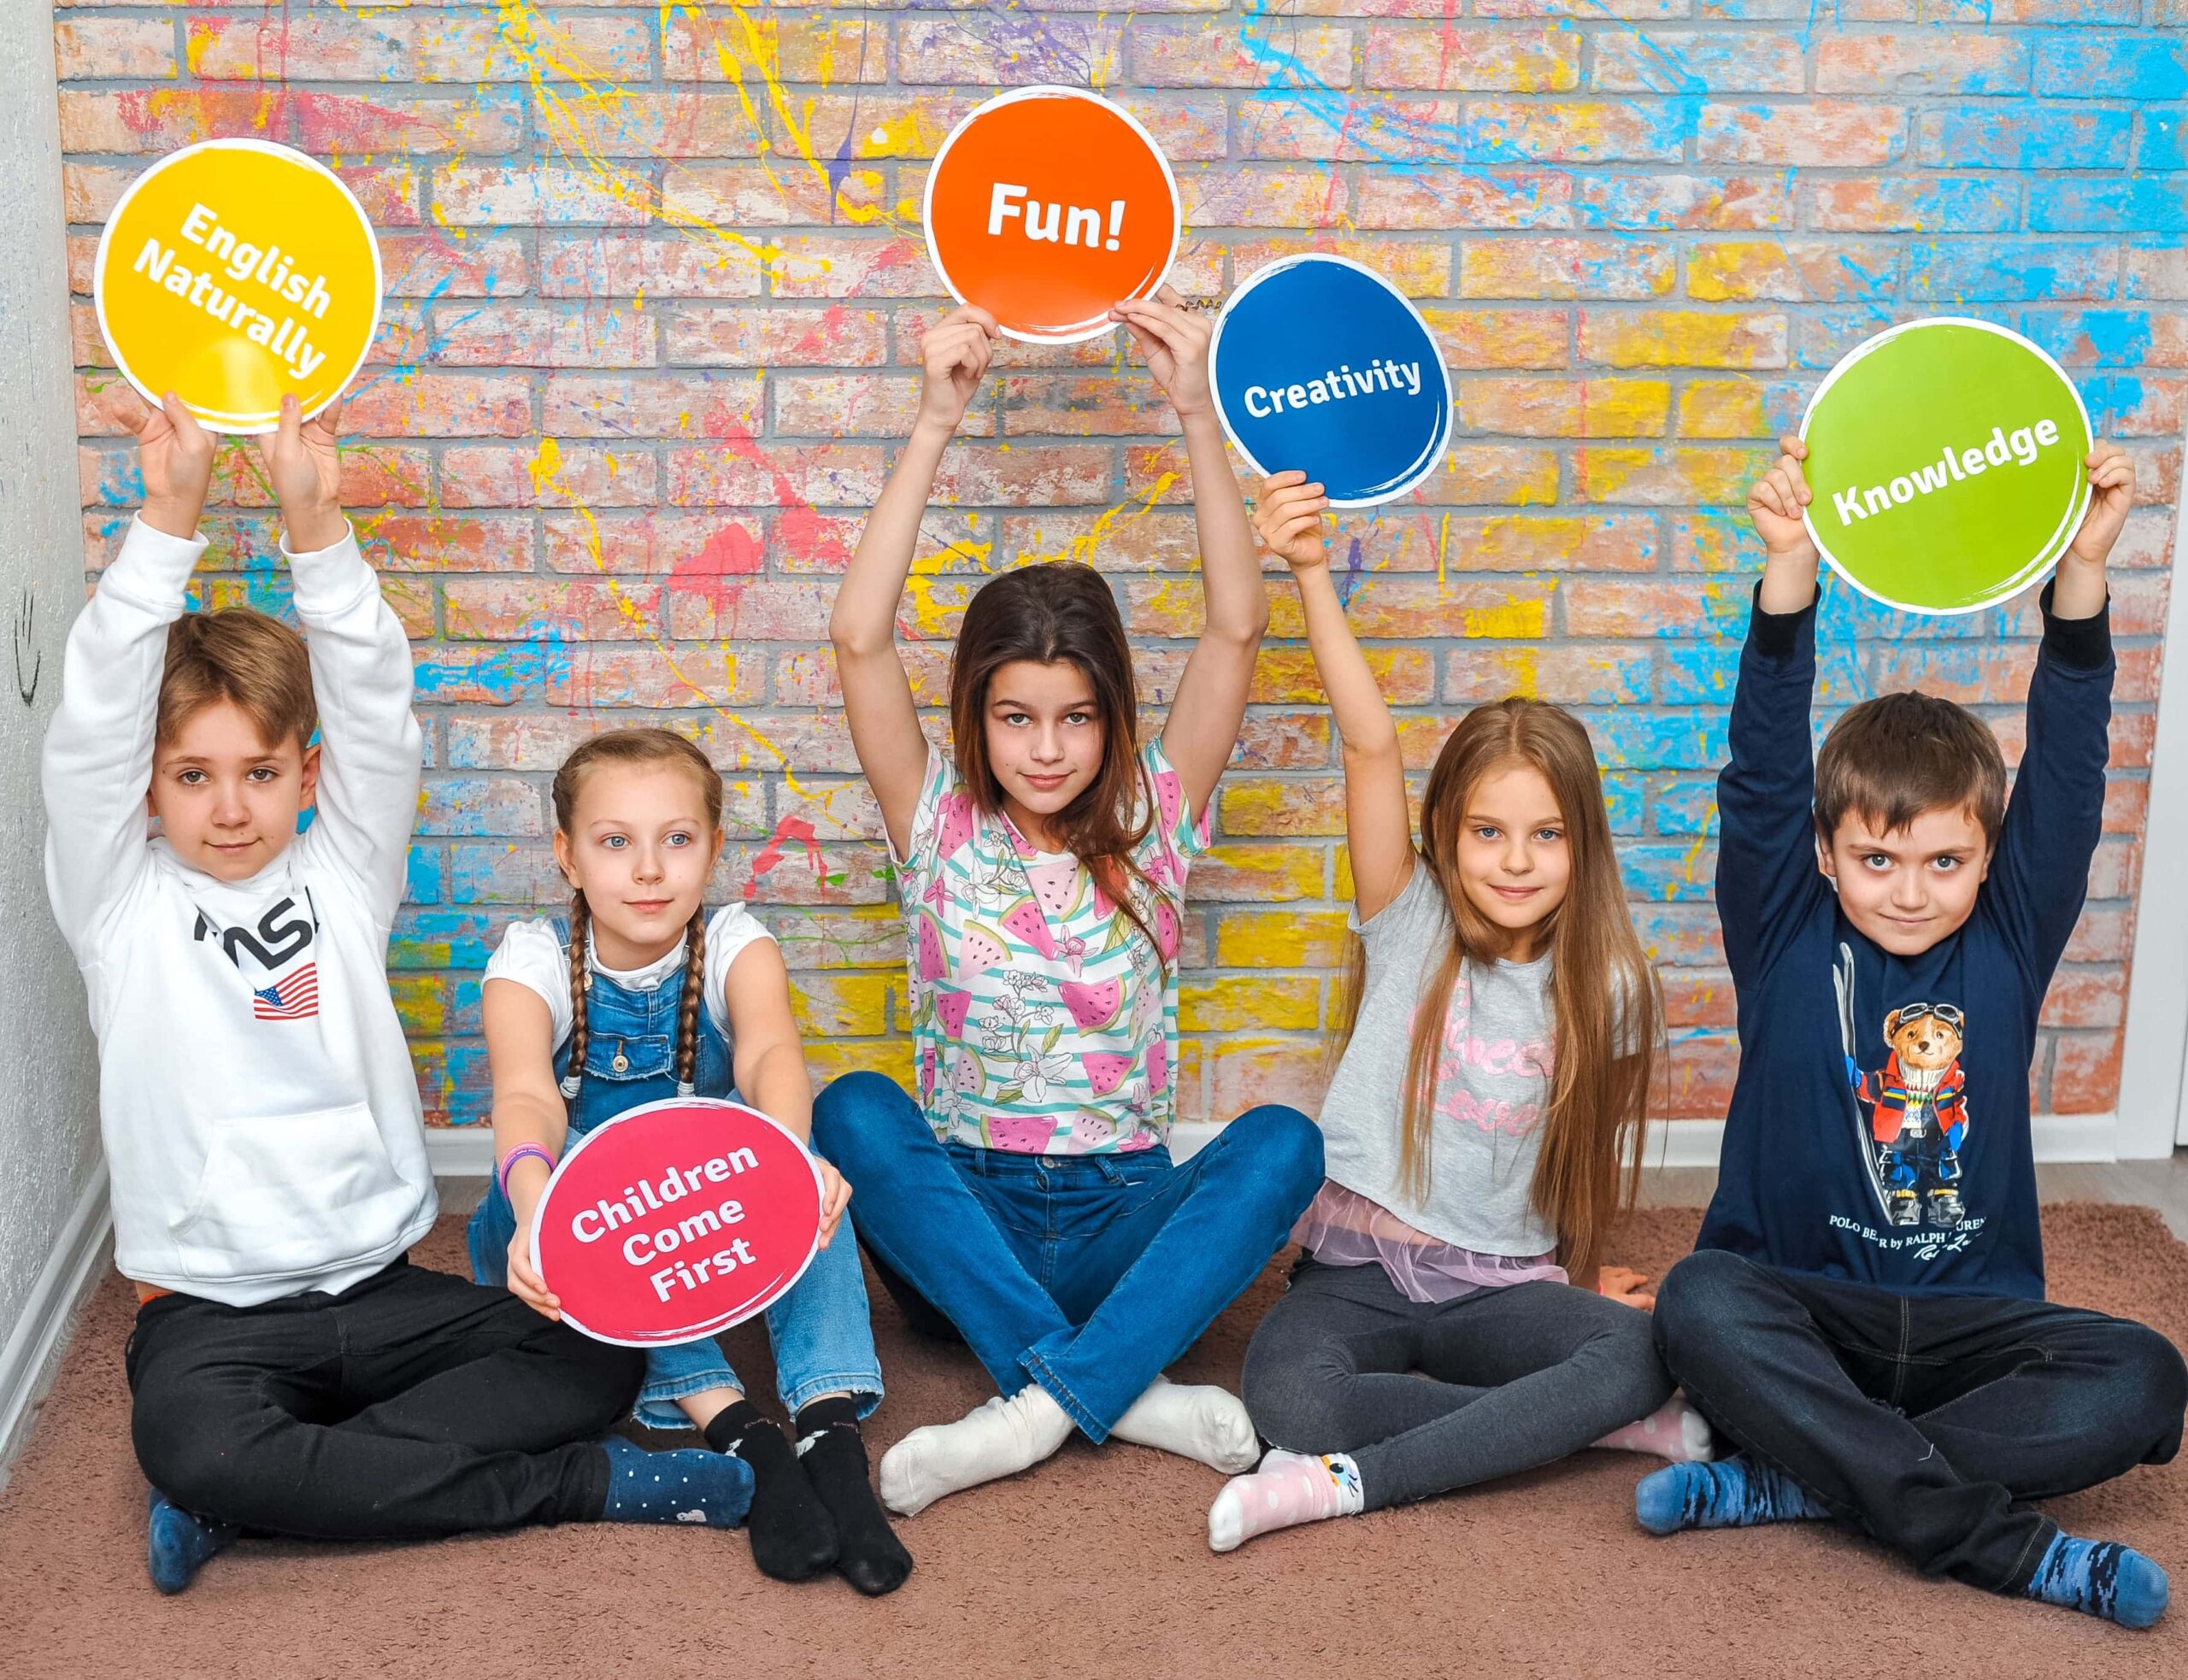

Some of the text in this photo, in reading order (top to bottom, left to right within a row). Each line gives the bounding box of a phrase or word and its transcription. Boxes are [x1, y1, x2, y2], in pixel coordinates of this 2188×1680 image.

[987, 182, 1126, 251] Fun!
[180, 203, 331, 319] English
[133, 238, 326, 379] Naturally
[1244, 359, 1420, 418] Creativity
[1832, 419, 2060, 526] Knowledge
[571, 1147, 759, 1243] Children
[623, 1200, 745, 1266] Come
[1829, 1215, 1861, 1232] POLO
[1862, 1226, 1887, 1248] BER
[1891, 1237, 1903, 1250] by
[1905, 1232, 1945, 1247] RALPH
[650, 1237, 756, 1303] First
